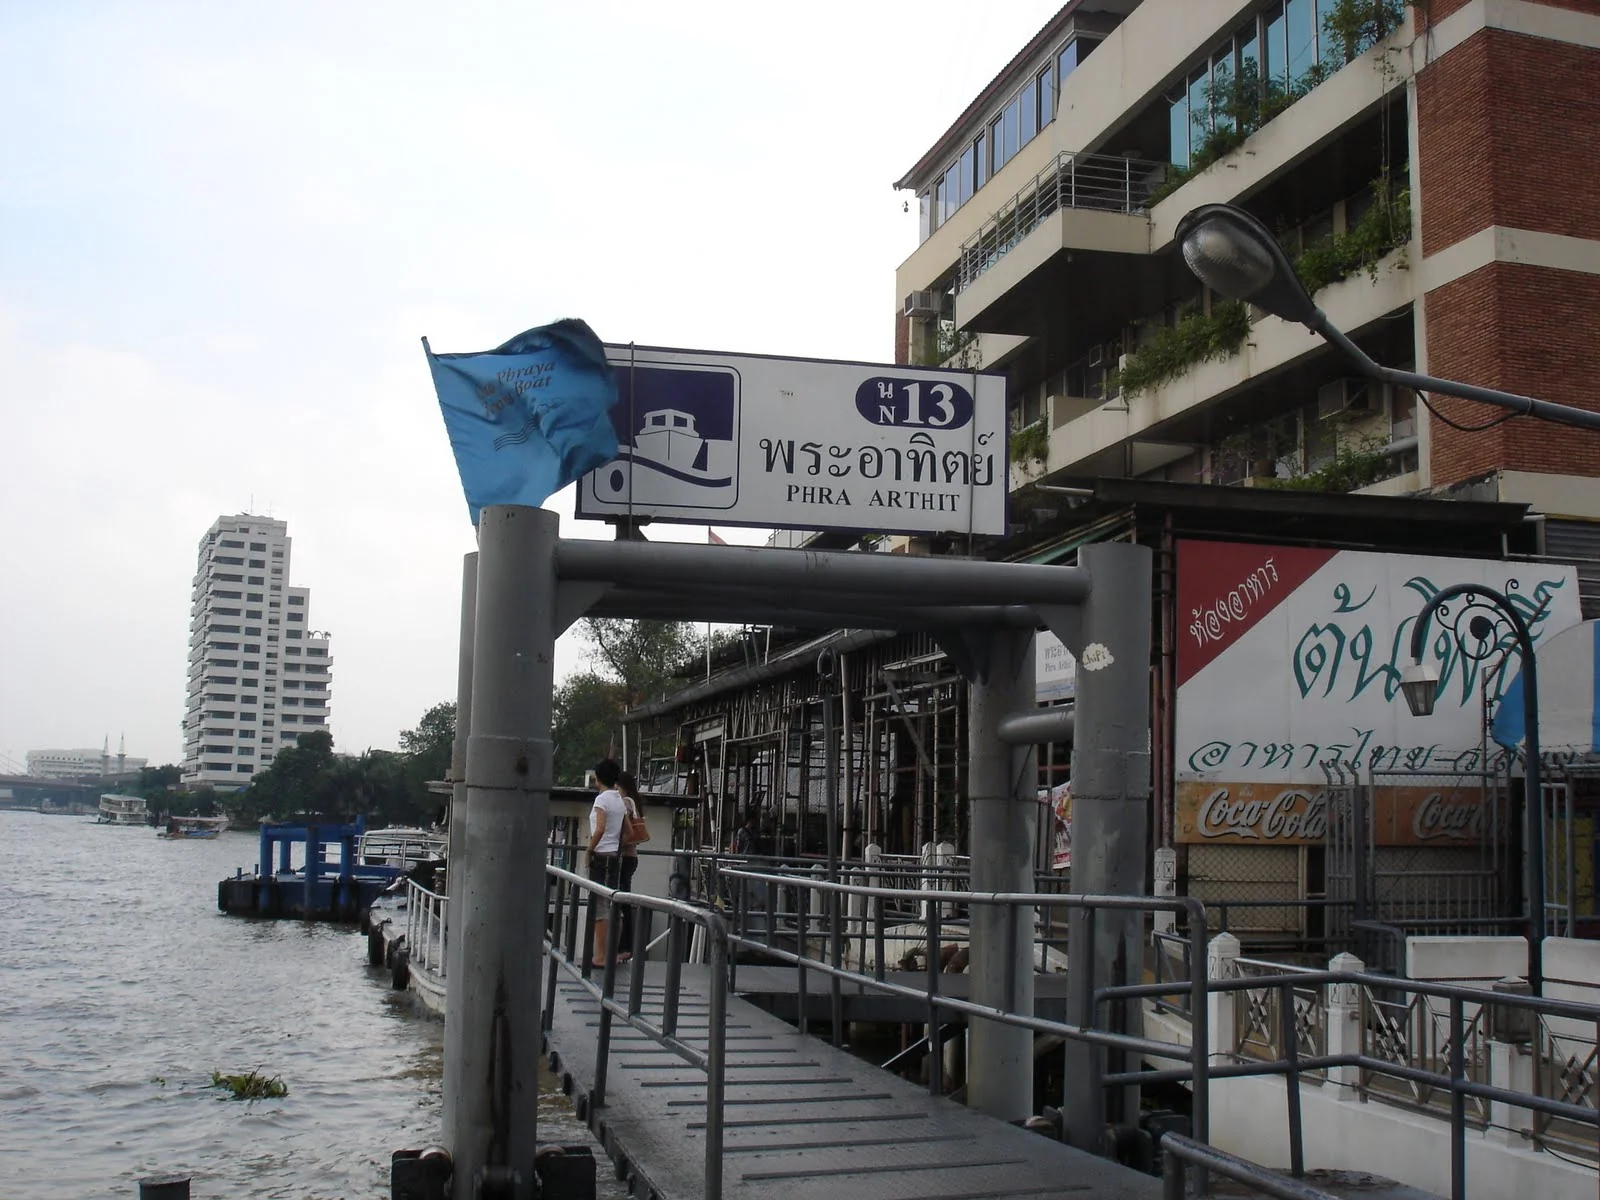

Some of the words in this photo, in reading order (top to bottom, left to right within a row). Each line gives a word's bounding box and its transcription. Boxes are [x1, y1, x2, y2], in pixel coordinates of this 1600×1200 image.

[877, 381, 894, 399] น
[878, 405, 896, 424] N
[902, 382, 956, 426] 13
[759, 431, 995, 486] พระอาทิตย์
[786, 484, 852, 506] PHRA
[868, 489, 960, 512] ARTHIT
[1190, 557, 1279, 648] ห้องอาหาร
[1197, 787, 1329, 840] Coca-Cola
